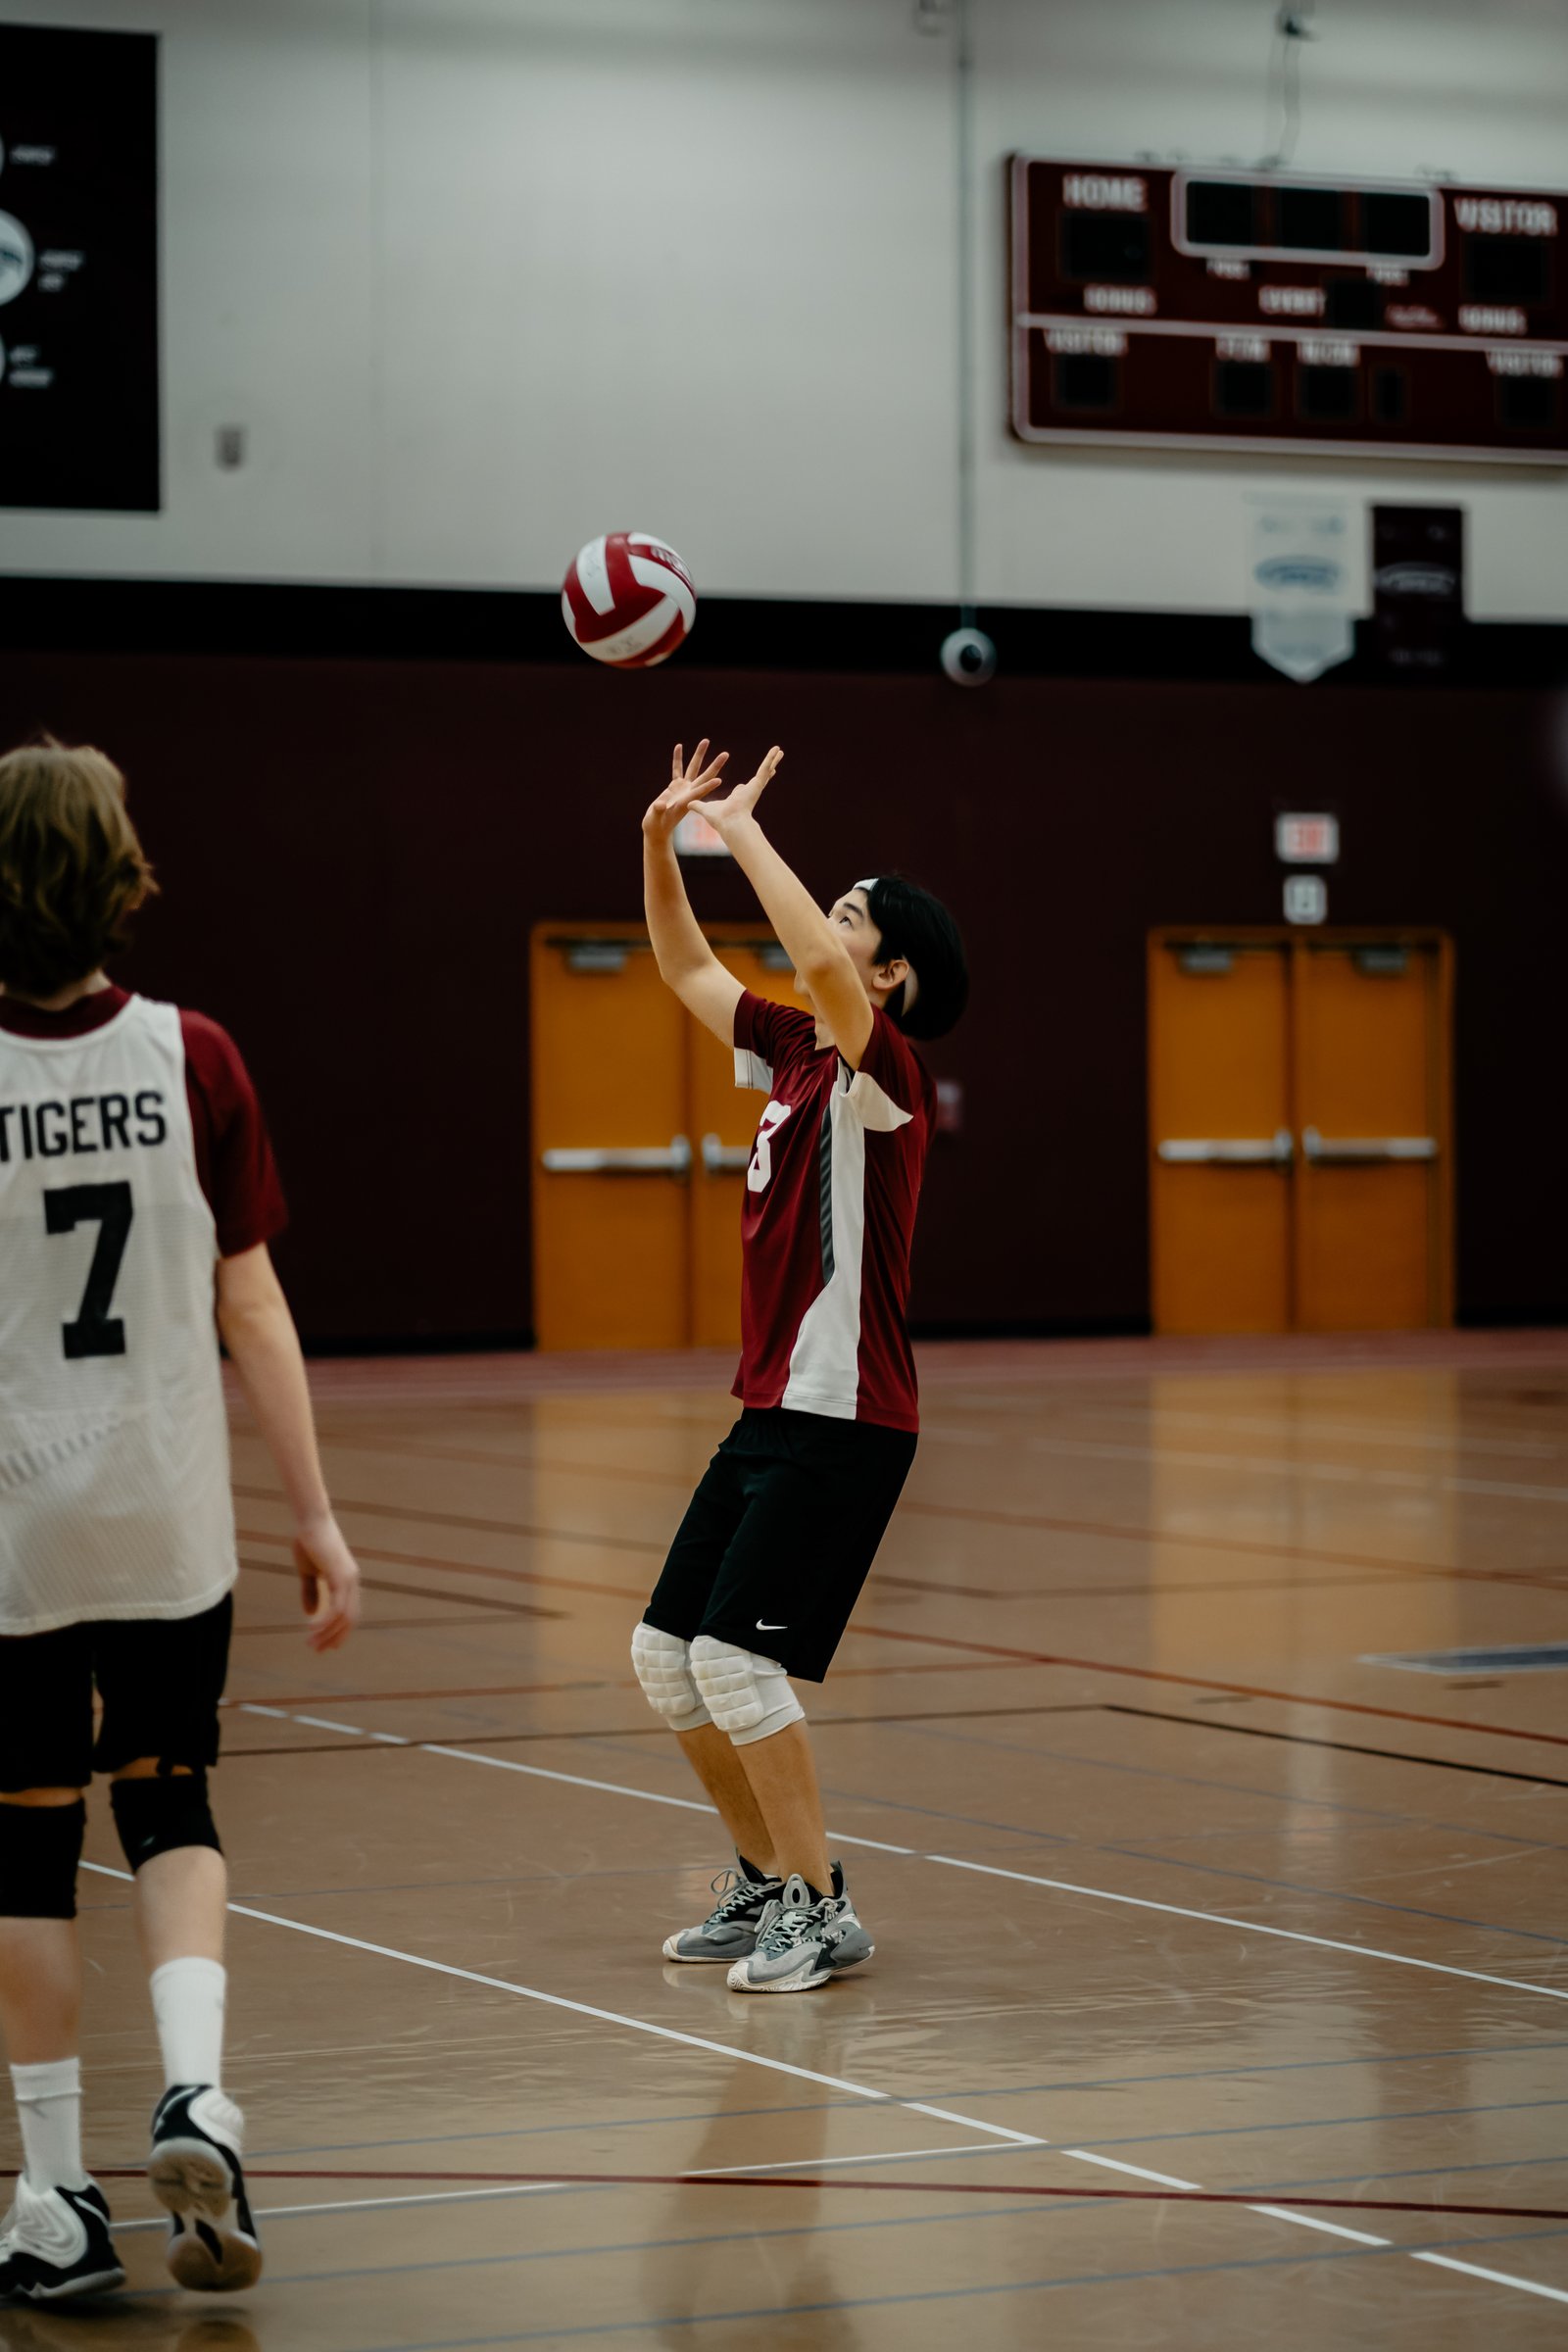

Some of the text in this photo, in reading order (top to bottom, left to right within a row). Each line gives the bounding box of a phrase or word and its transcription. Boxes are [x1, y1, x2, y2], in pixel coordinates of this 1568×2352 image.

[1063, 172, 1148, 212] HOME
[1454, 198, 1557, 236] VISITOR
[0, 1090, 168, 1162] TIGERS
[43, 1180, 133, 1360] 7
